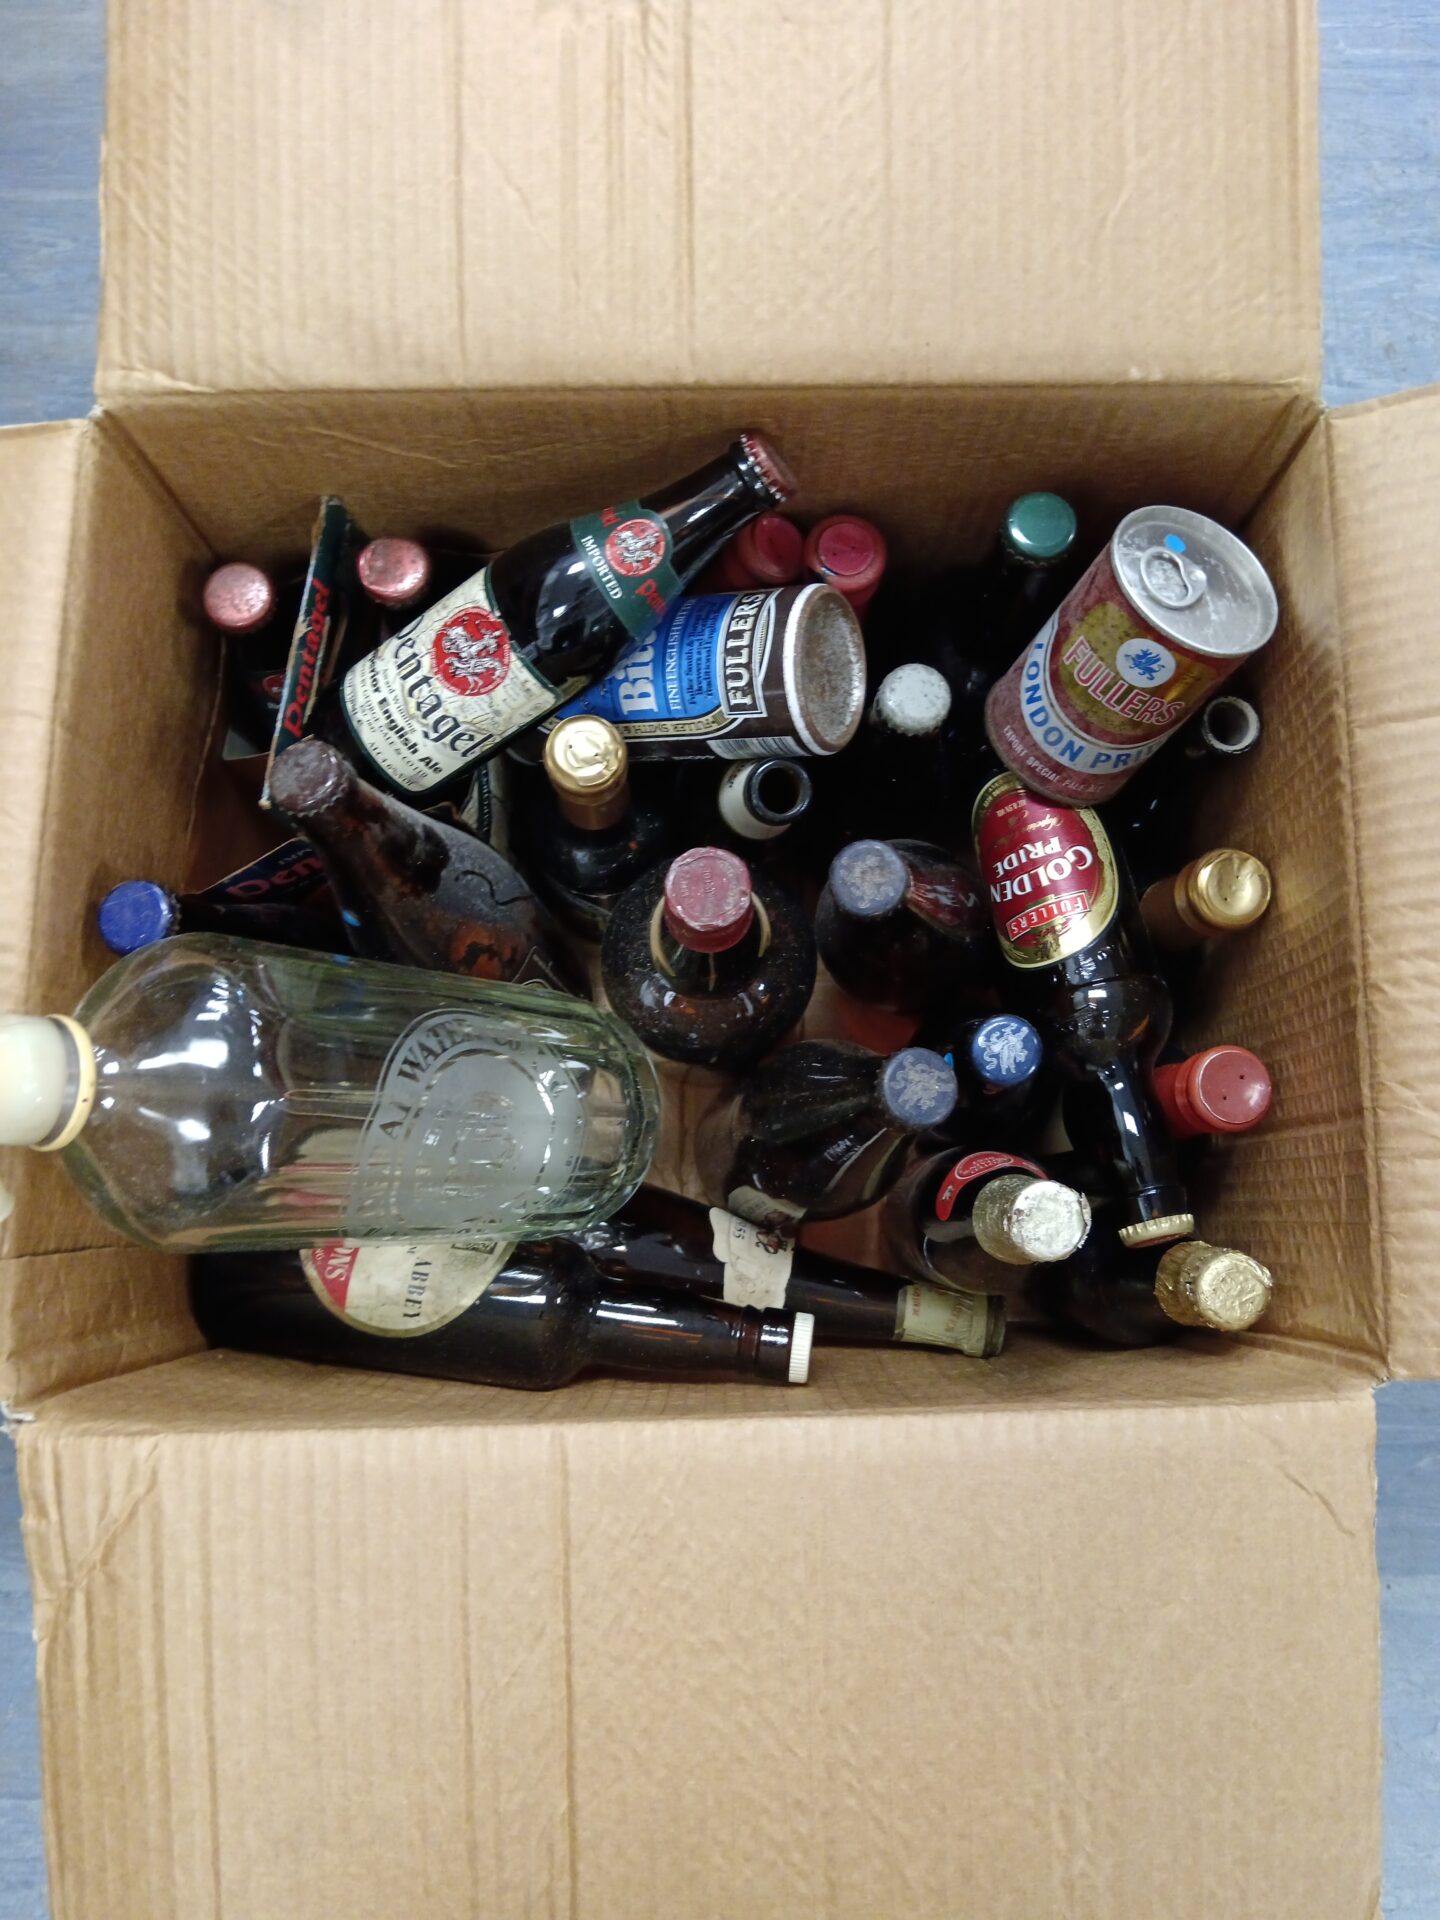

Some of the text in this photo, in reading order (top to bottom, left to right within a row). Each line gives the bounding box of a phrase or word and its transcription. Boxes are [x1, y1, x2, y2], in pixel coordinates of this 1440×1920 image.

[580, 535, 623, 599] IMPORTED
[666, 626, 682, 679] ENGLISH
[685, 648, 694, 675] Smith
[728, 593, 767, 706] FULLERS
[666, 680, 681, 710] FINE
[1062, 635, 1185, 725] FULLERS
[378, 696, 420, 755] English
[418, 755, 444, 775] Ale
[392, 695, 417, 734] Winning
[1002, 724, 1027, 757] EXPORT
[1025, 756, 1060, 784] SPECIAL
[1088, 743, 1155, 770] PRI
[988, 842, 1095, 903] GOLDEN
[992, 834, 1063, 879] PRIDE
[403, 1259, 432, 1318] ABBEY
